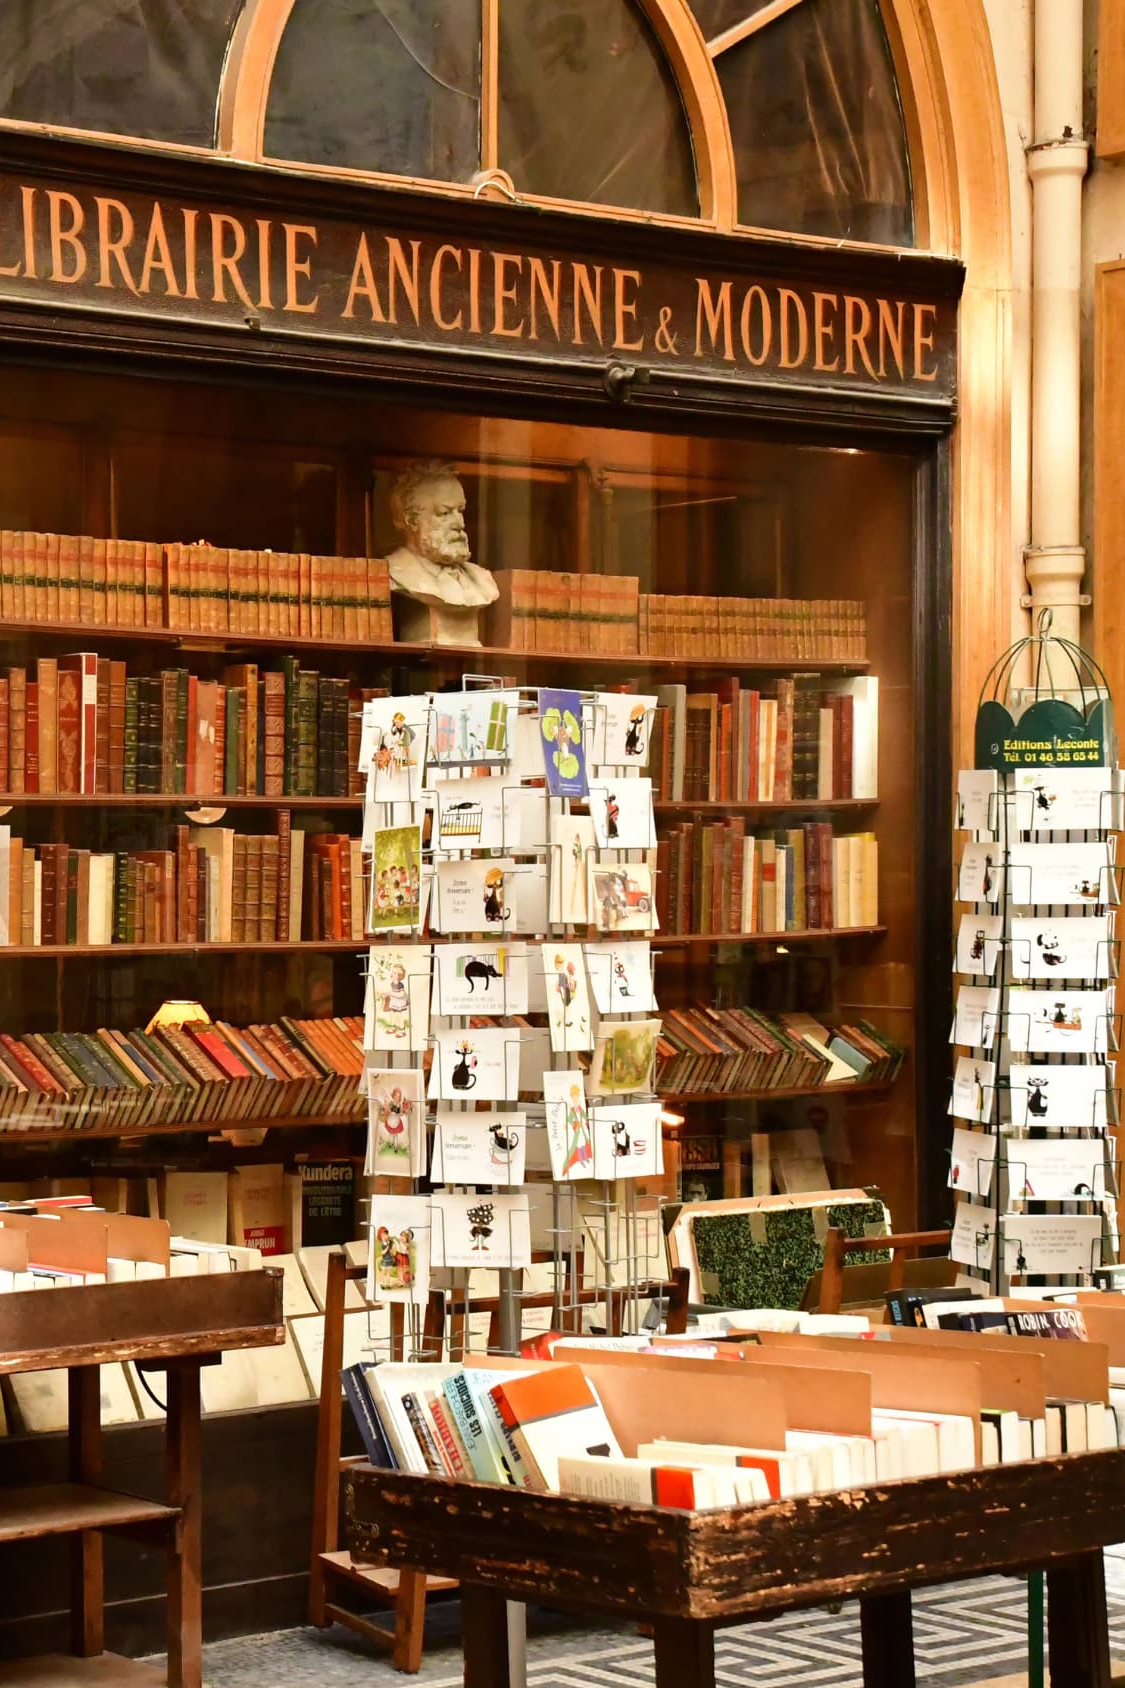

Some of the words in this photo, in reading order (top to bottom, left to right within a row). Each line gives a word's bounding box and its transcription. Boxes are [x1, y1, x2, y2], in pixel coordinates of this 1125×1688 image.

[341, 231, 645, 352] ANCIENNE
[654, 305, 680, 356] &
[693, 277, 939, 384] MODERNE
[1003, 739, 1053, 750] Editions
[1056, 738, 1100, 750] Leconte
[1024, 752, 1037, 762] 01
[1039, 752, 1054, 762] 46
[1087, 751, 1100, 761] 44
[298, 1164, 353, 1182] Kundera
[1017, 1313, 1051, 1331] ROBIN
[1053, 1310, 1085, 1329] COOK
[453, 1374, 476, 1420] SUICIDES
[469, 1419, 482, 1438] LES
